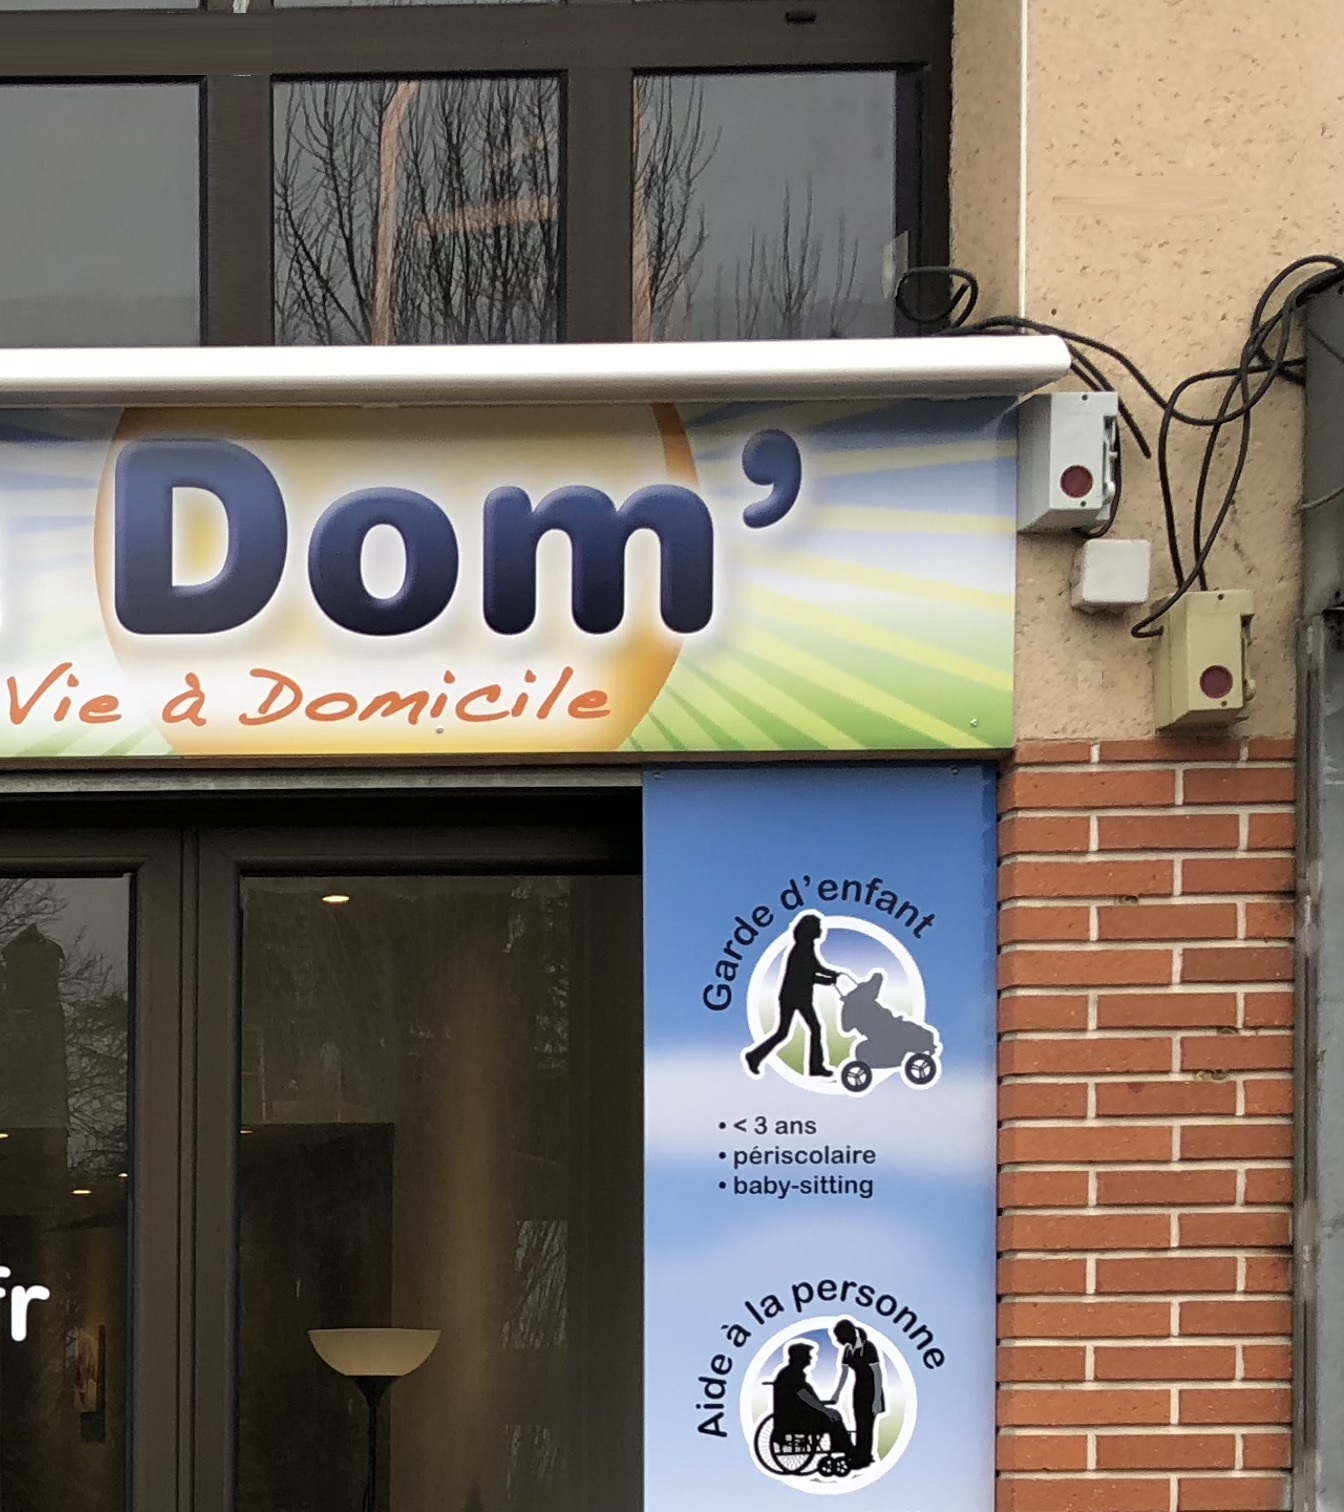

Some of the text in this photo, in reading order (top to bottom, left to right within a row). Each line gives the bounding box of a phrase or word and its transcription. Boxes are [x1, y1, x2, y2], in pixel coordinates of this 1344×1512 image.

[113, 428, 802, 637] Dom'
[6, 662, 123, 726] Vie
[160, 672, 209, 727] à
[237, 667, 611, 726] Domicile
[702, 874, 938, 1012] Garde d'enfant
[733, 1146, 877, 1170] périscolaire
[754, 1116, 768, 1136] 3
[774, 1120, 818, 1136] ans
[733, 1175, 874, 1200] baby-sitting
[695, 1278, 946, 1438] Aide à la personne
